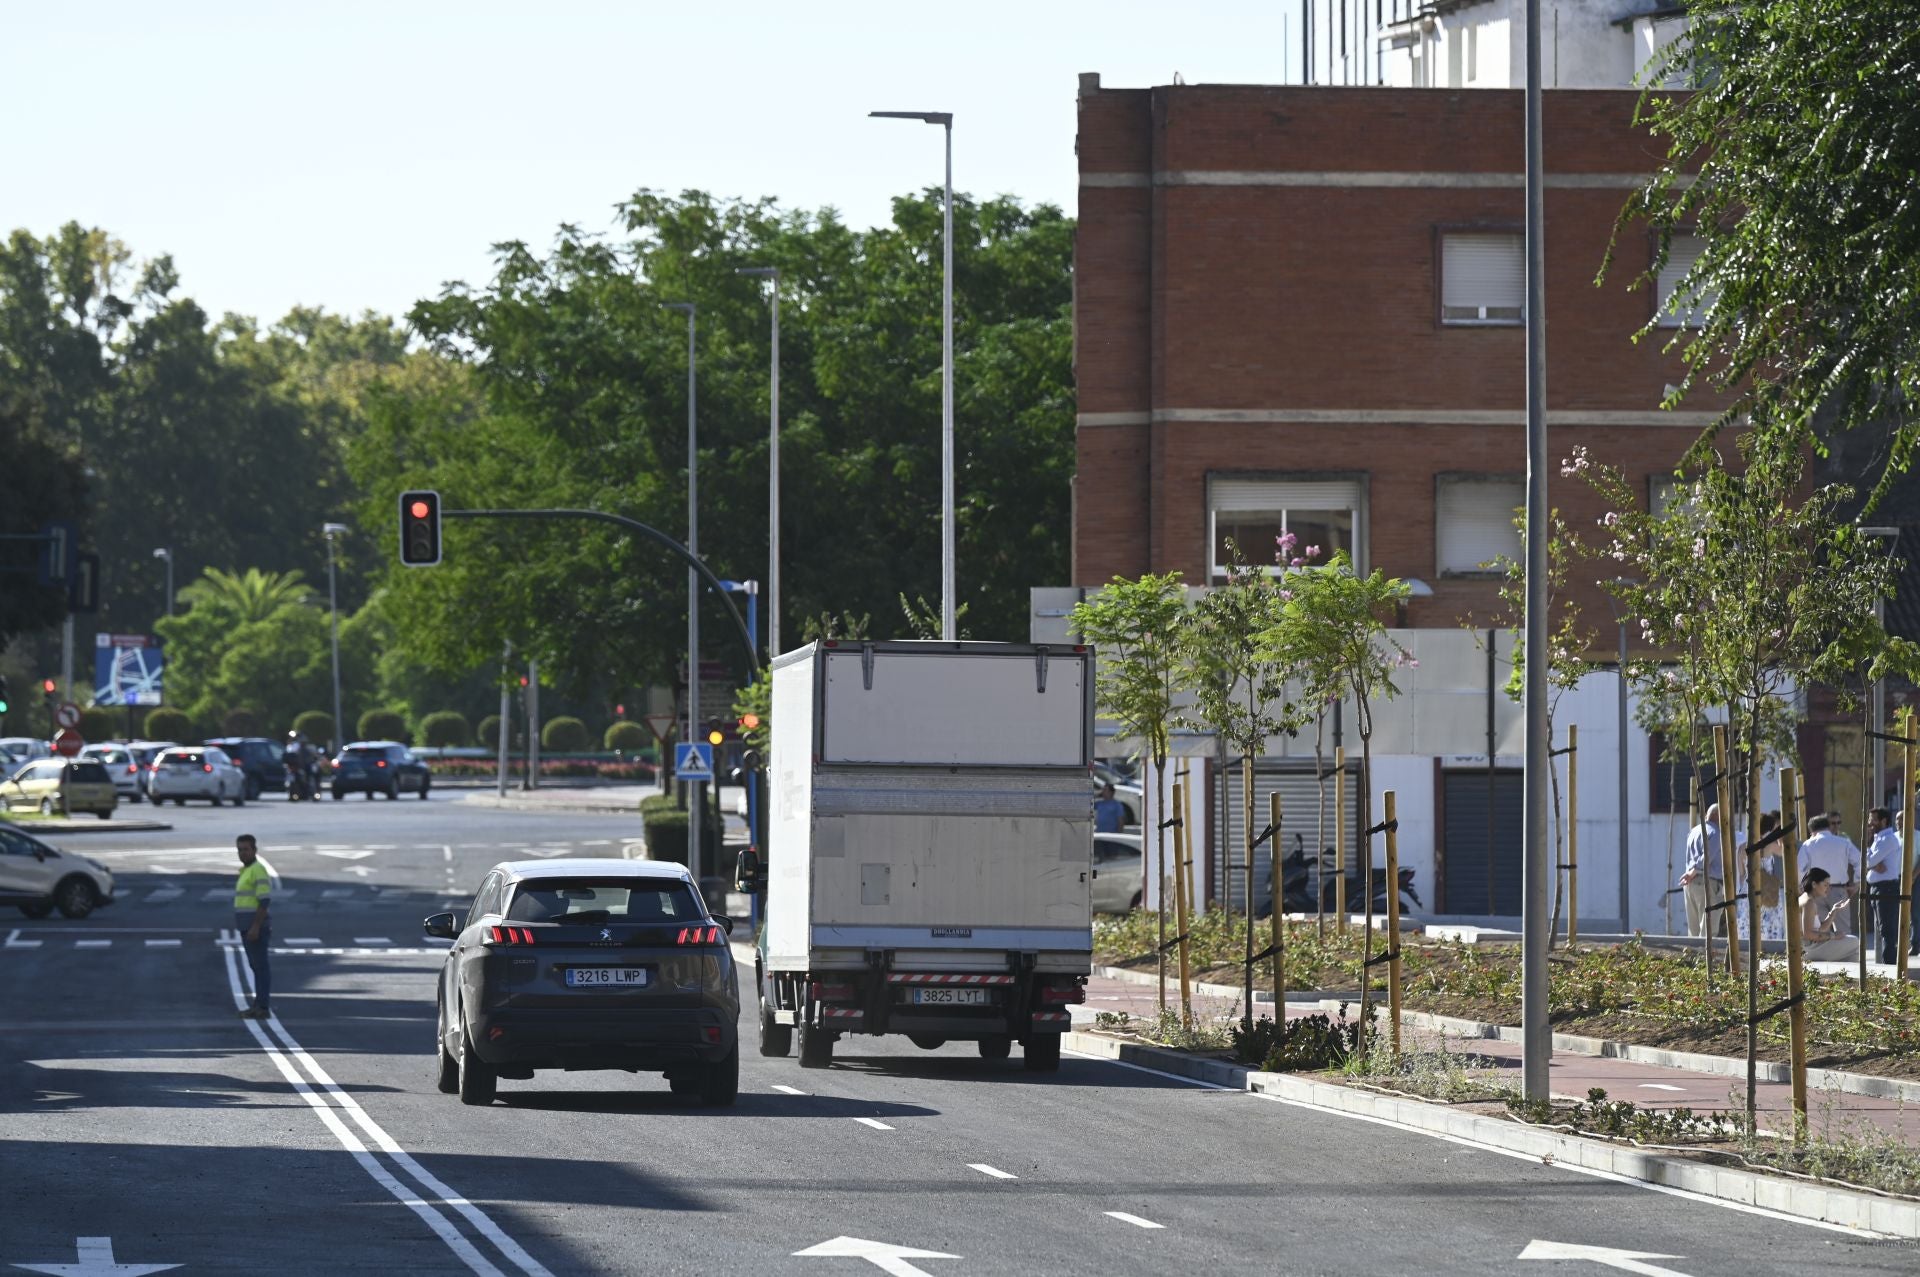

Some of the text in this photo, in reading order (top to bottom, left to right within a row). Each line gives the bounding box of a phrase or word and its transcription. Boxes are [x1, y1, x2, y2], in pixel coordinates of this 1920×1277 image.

[577, 970, 640, 983] 3216 LWP
[924, 990, 979, 1002] 3825 LYT
